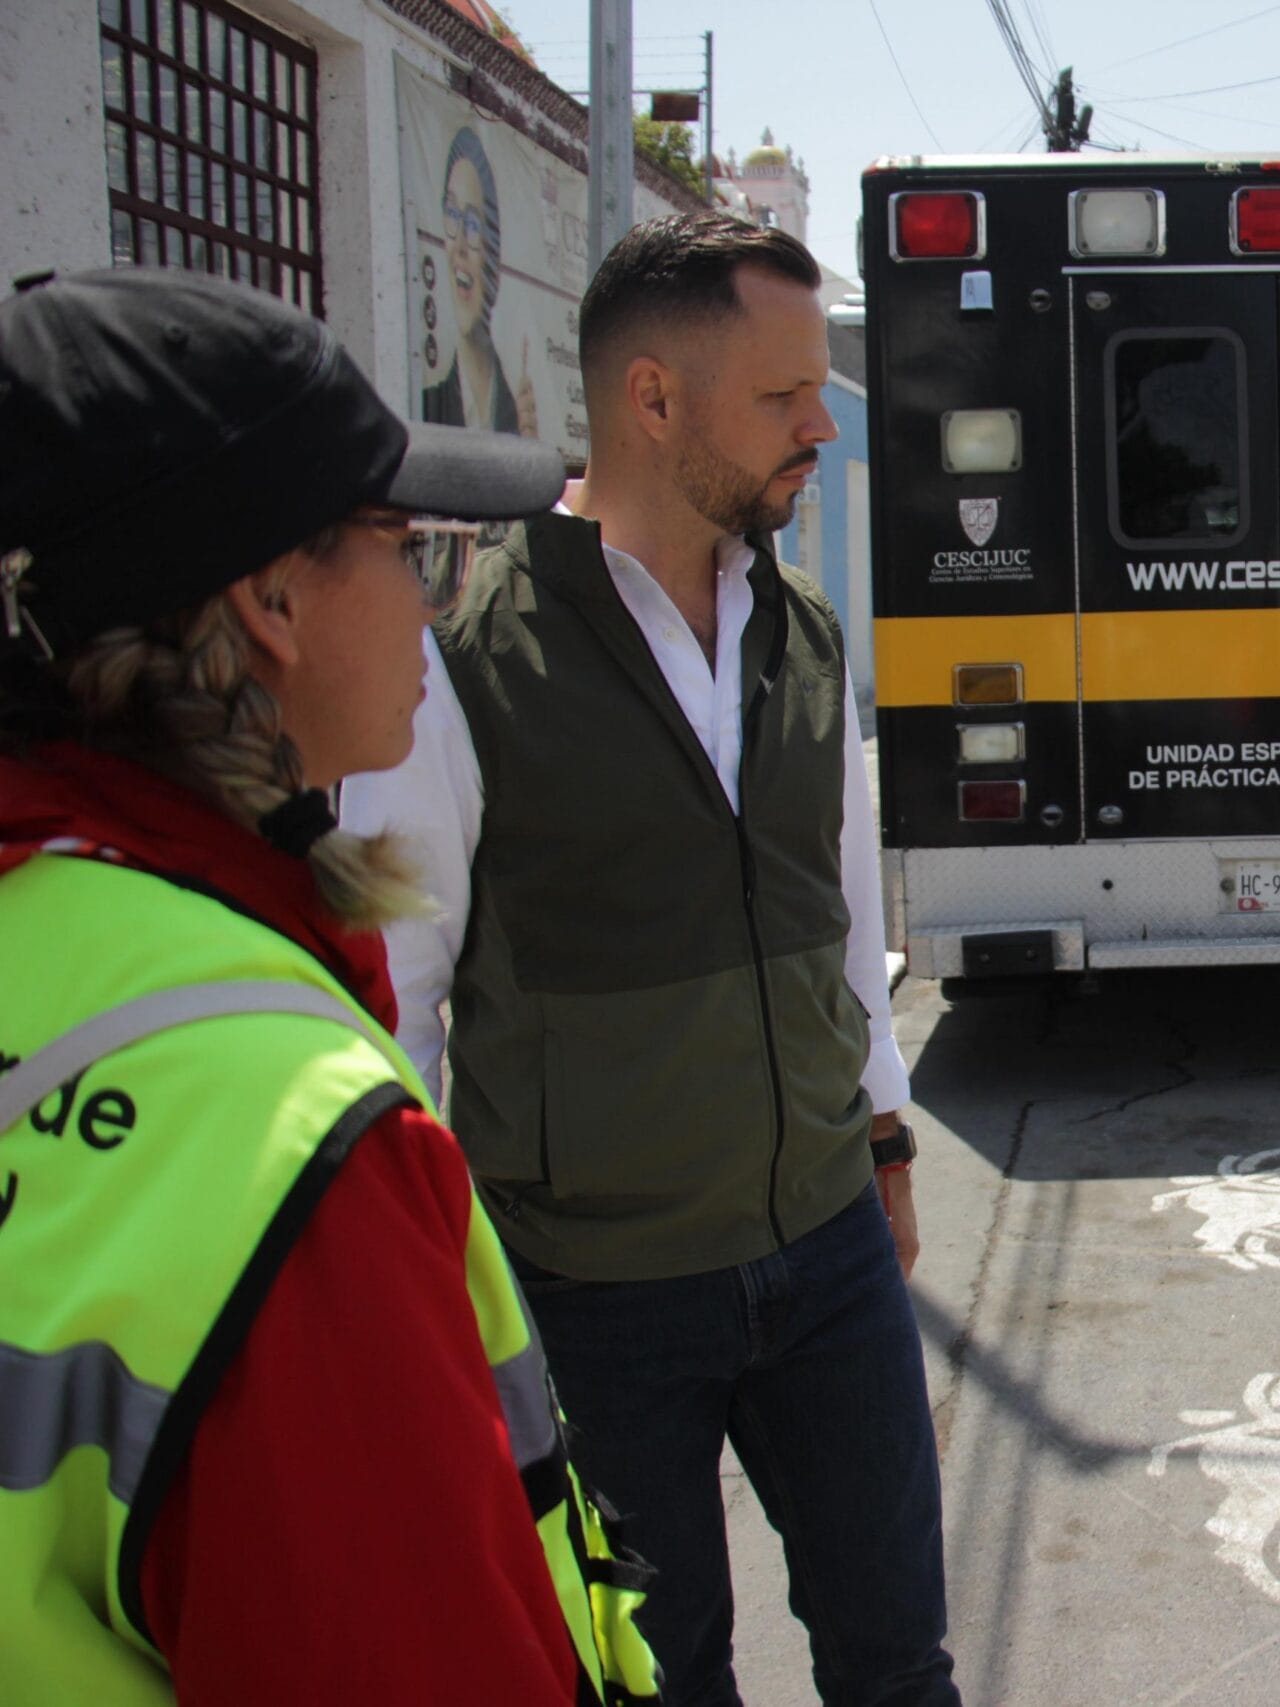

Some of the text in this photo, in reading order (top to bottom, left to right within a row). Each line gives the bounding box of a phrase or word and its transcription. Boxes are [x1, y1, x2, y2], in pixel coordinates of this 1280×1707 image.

[934, 549, 1029, 568] CESCIJUC
[1146, 743, 1235, 764] UNIDAD
[1129, 770, 1160, 789] DE
